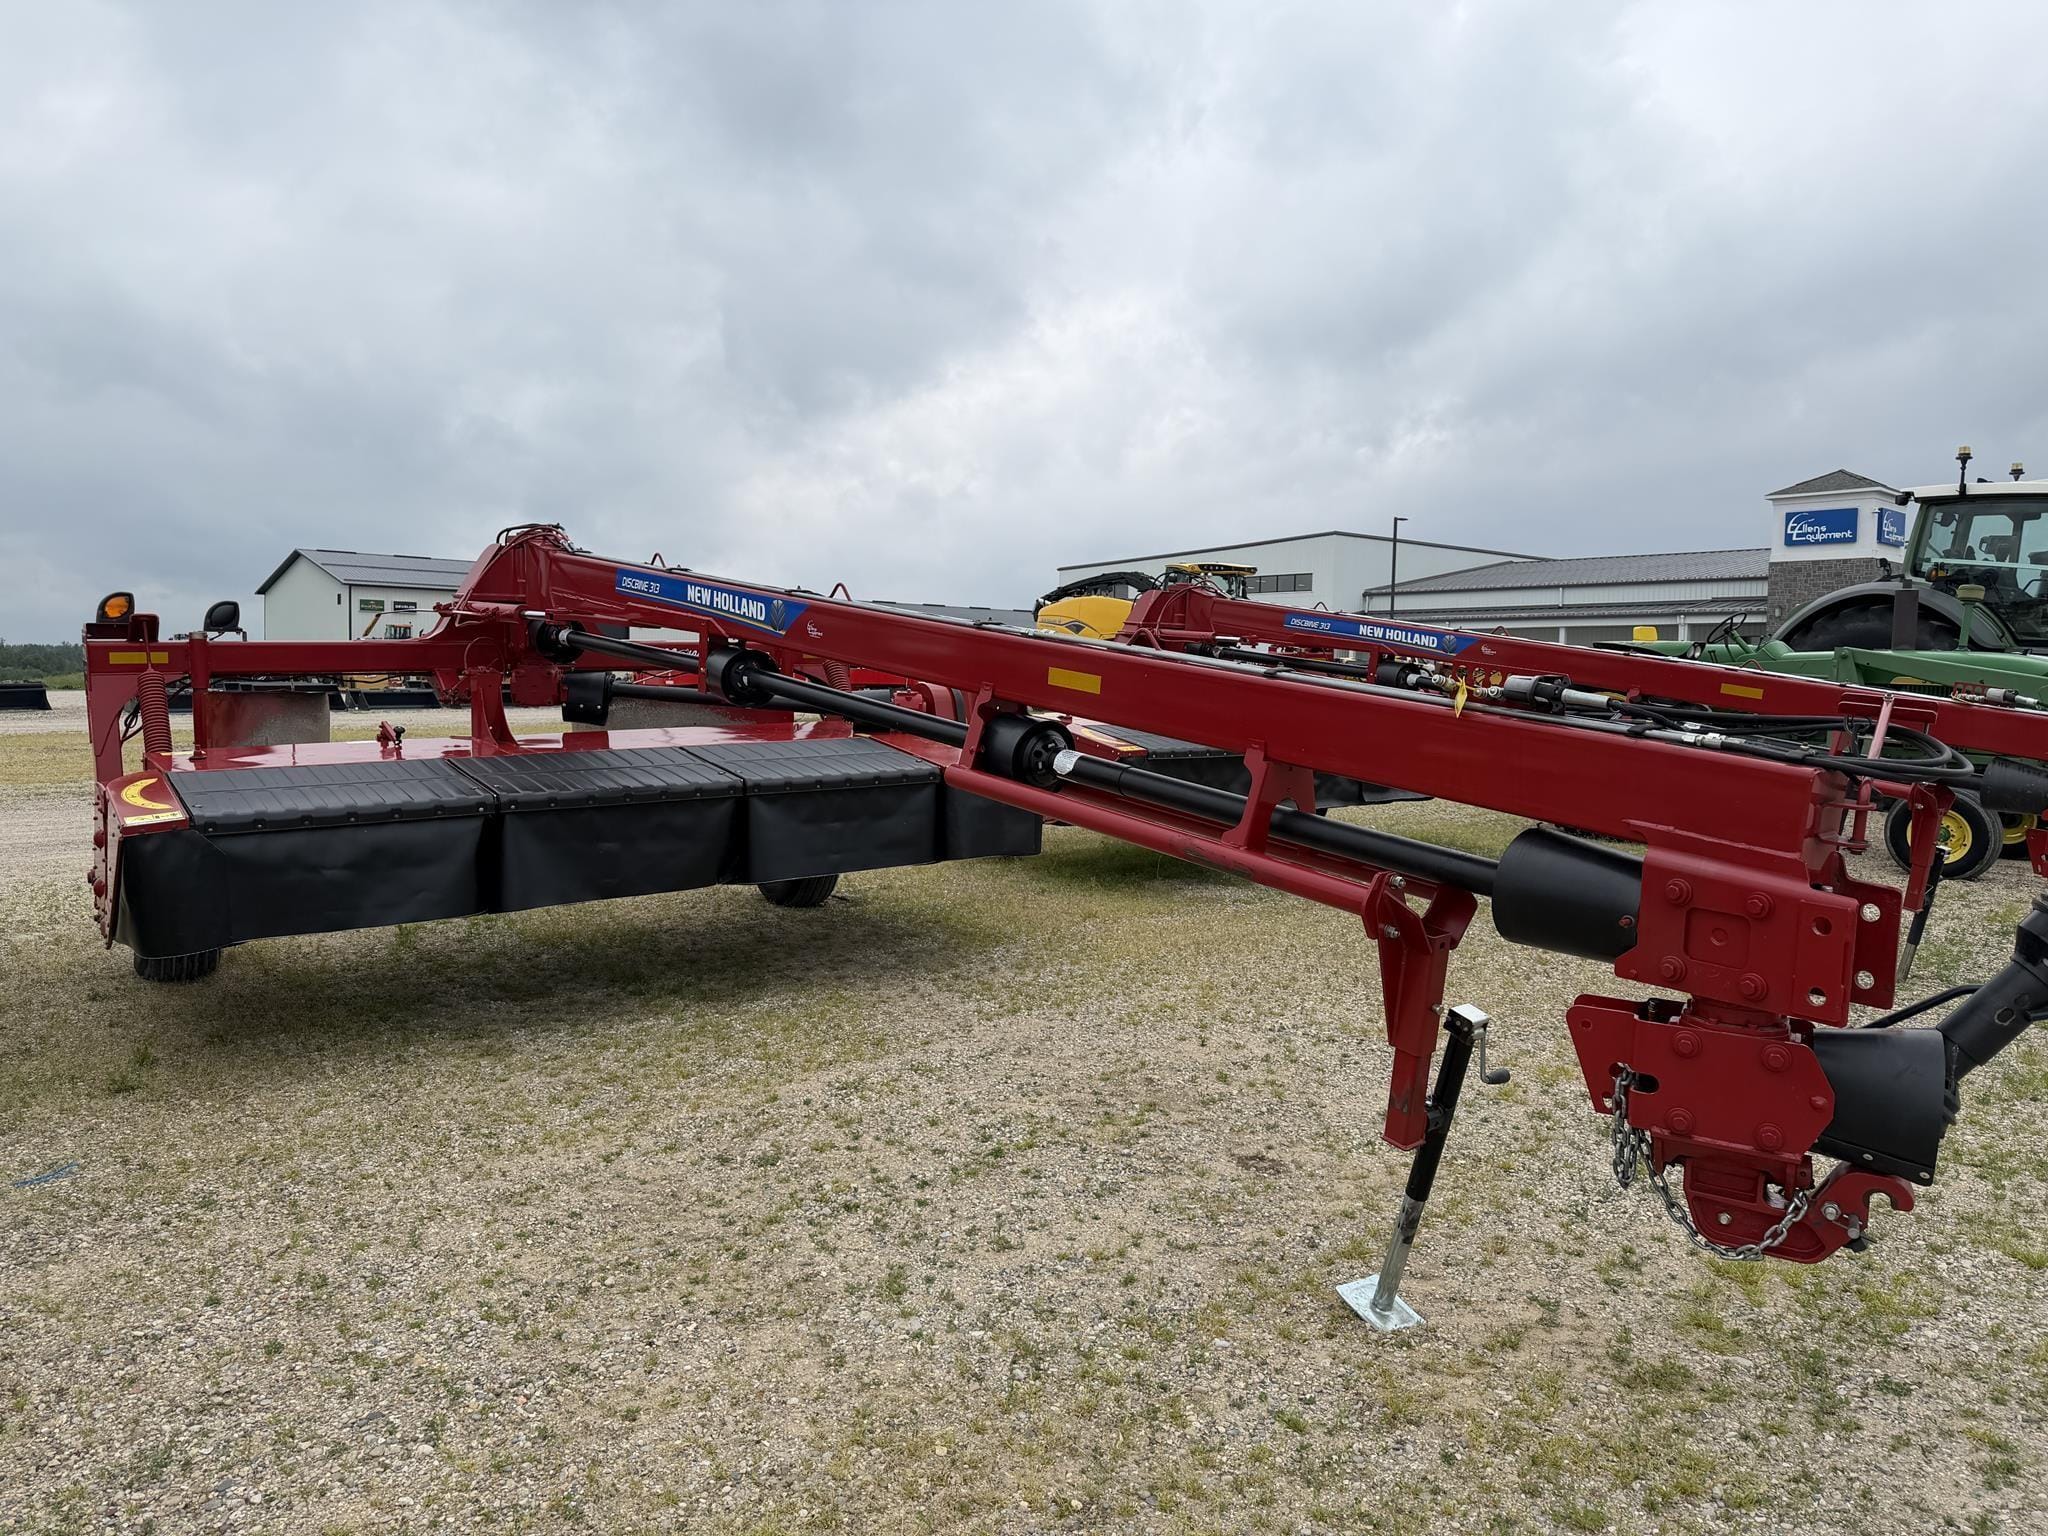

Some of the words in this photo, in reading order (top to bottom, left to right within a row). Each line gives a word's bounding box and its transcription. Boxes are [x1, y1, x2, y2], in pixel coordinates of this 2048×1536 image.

[1787, 512, 1827, 533] Ellens
[1792, 518, 1853, 542] Equipment
[621, 576, 649, 592] DISCBINE
[649, 582, 661, 594] 313
[687, 584, 712, 606] NEW
[713, 590, 766, 621] HOLLAND
[1290, 618, 1319, 629] DISCBINE
[1319, 622, 1331, 630] 313
[1359, 624, 1384, 639] NEW
[1385, 628, 1438, 648] HOLLAND
